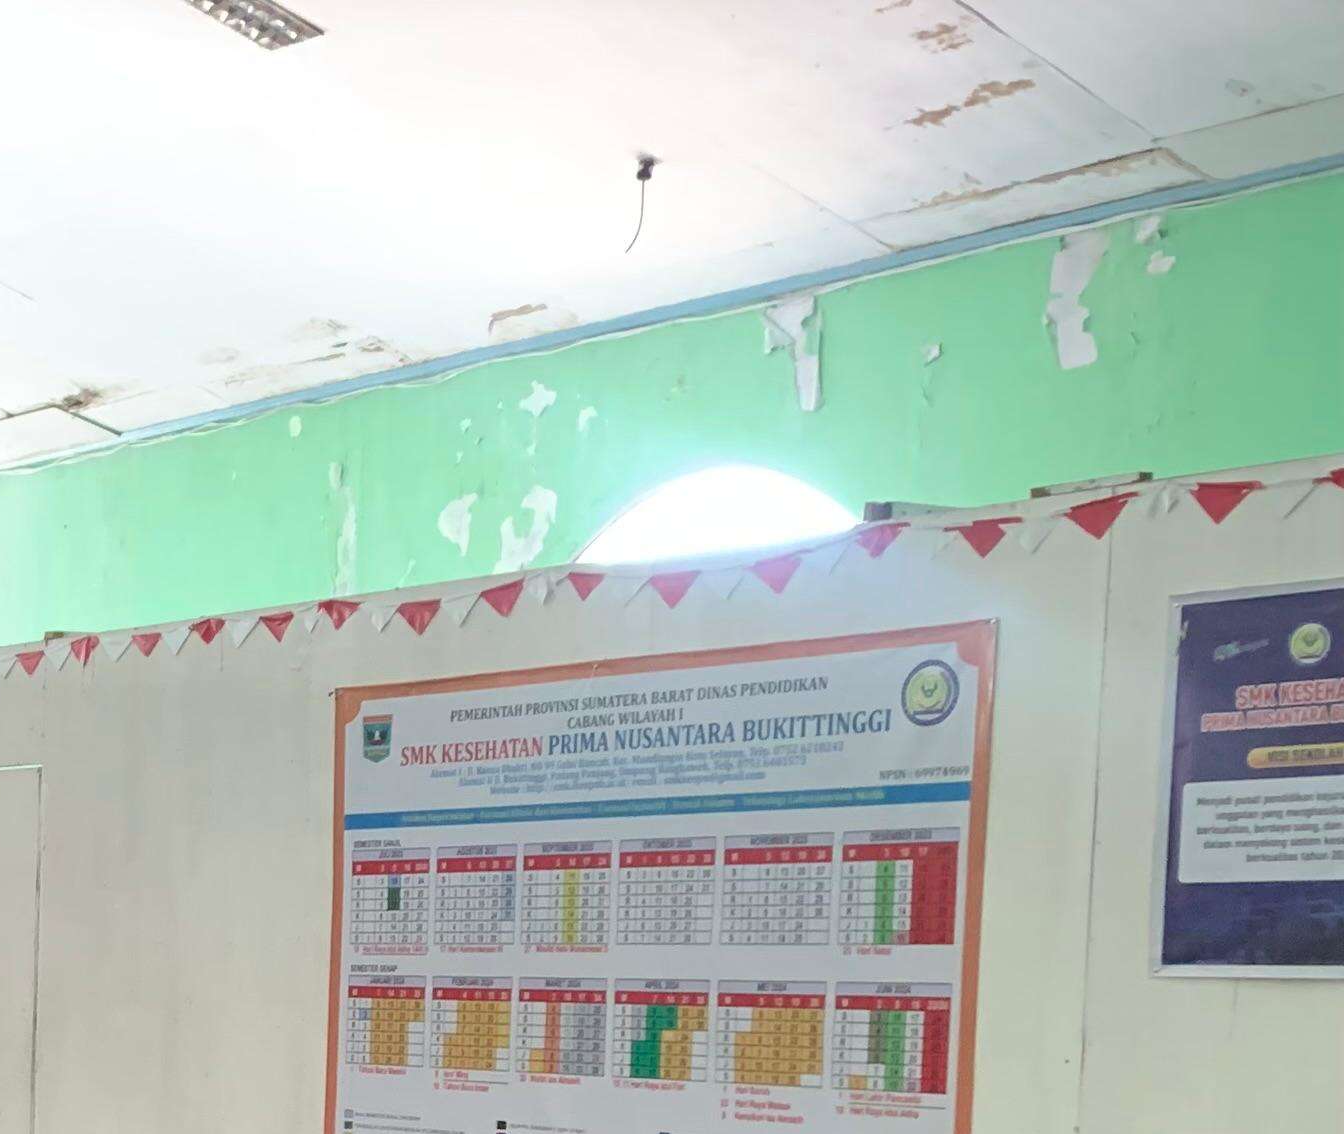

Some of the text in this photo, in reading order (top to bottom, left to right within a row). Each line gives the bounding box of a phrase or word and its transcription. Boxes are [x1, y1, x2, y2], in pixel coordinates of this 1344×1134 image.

[450, 676, 828, 722] PEMERINTAH PROVINSI SUMATERA BARAT DINAS PENDIDIKAN
[567, 714, 615, 730] CABANG
[618, 709, 677, 726] WILAYAH
[400, 744, 437, 767] SMK
[442, 735, 543, 763] KESEHATAN
[548, 731, 608, 755] PRIMA
[615, 721, 736, 750] NUSANTARA
[743, 709, 892, 743] BUKITTINGGI
